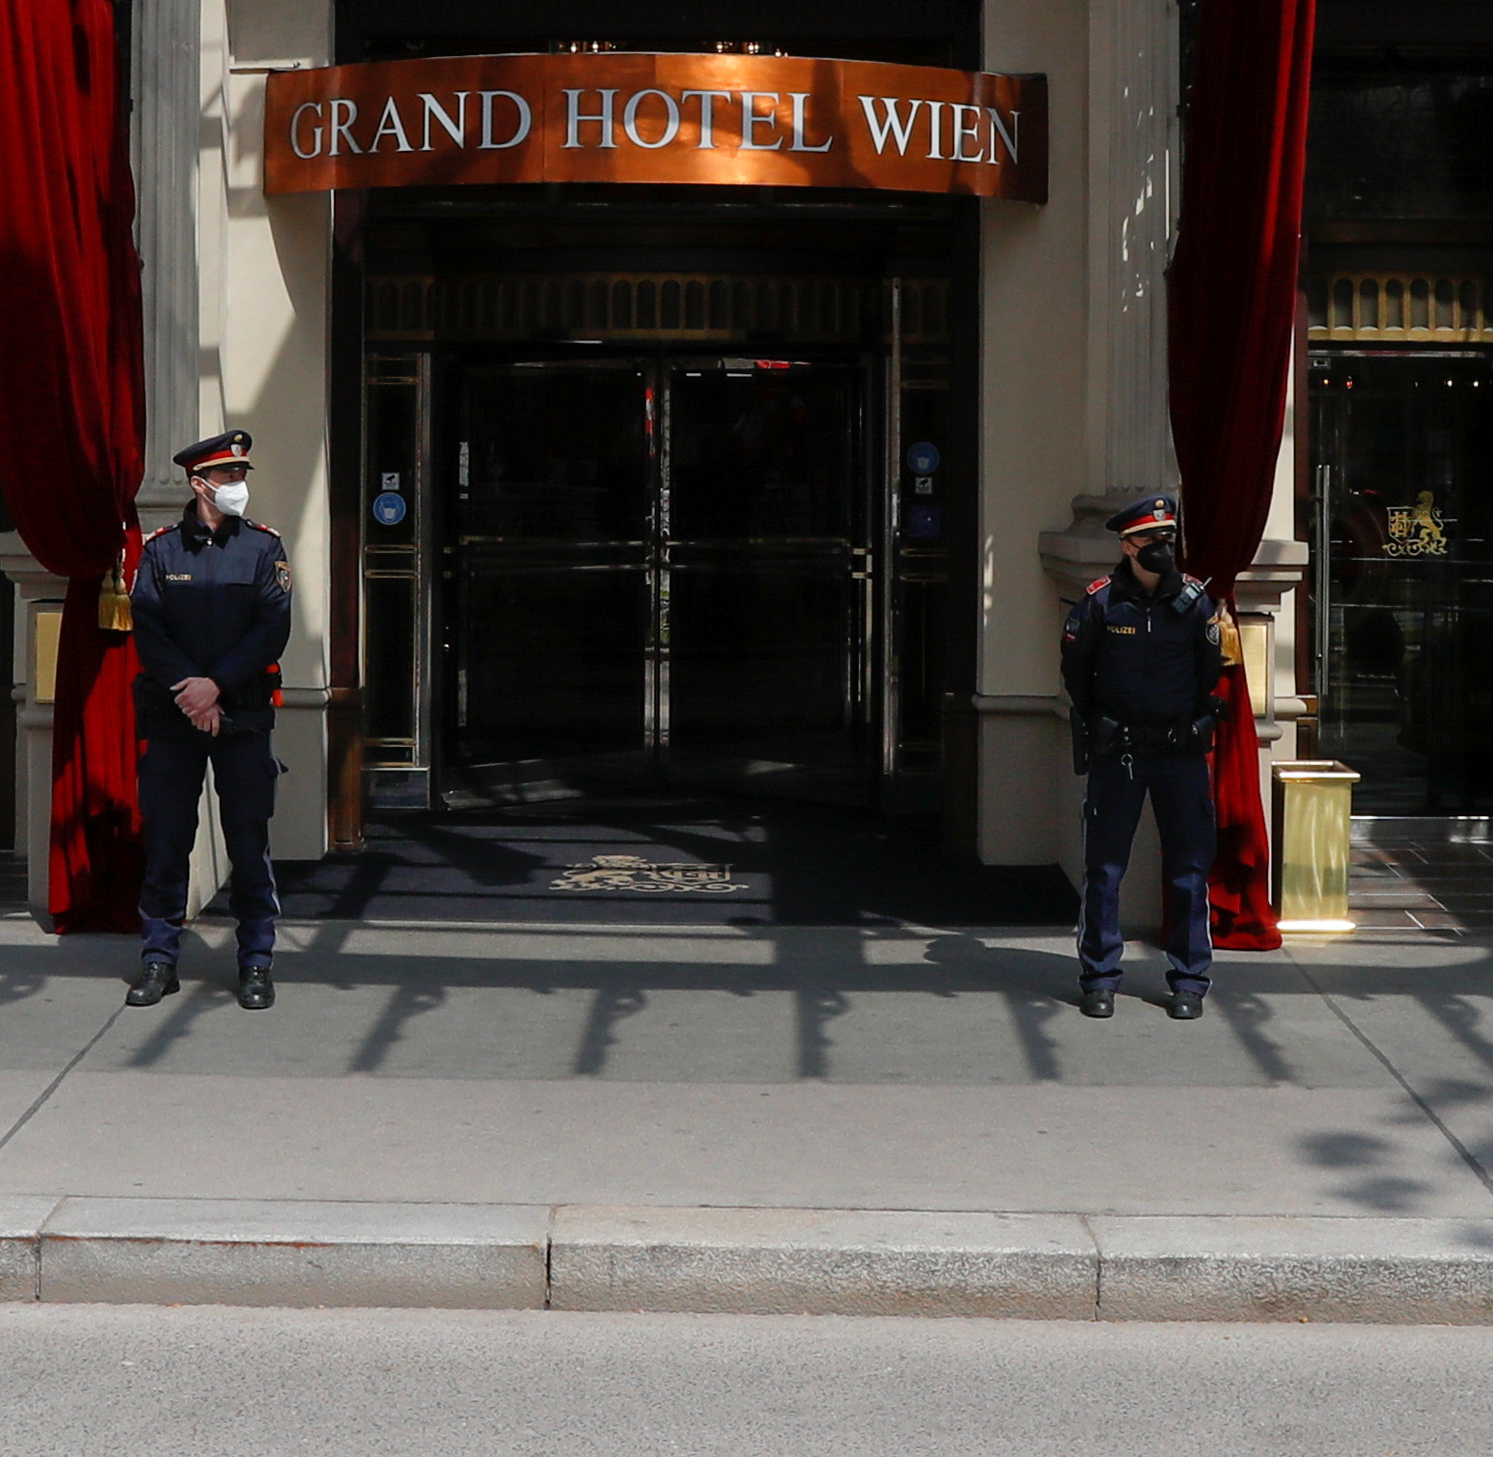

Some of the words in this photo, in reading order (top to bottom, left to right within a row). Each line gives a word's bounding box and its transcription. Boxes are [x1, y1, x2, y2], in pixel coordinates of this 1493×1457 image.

[290, 88, 533, 162] GRAND
[560, 87, 834, 154] HOTEL
[857, 94, 1023, 167] WIEN
